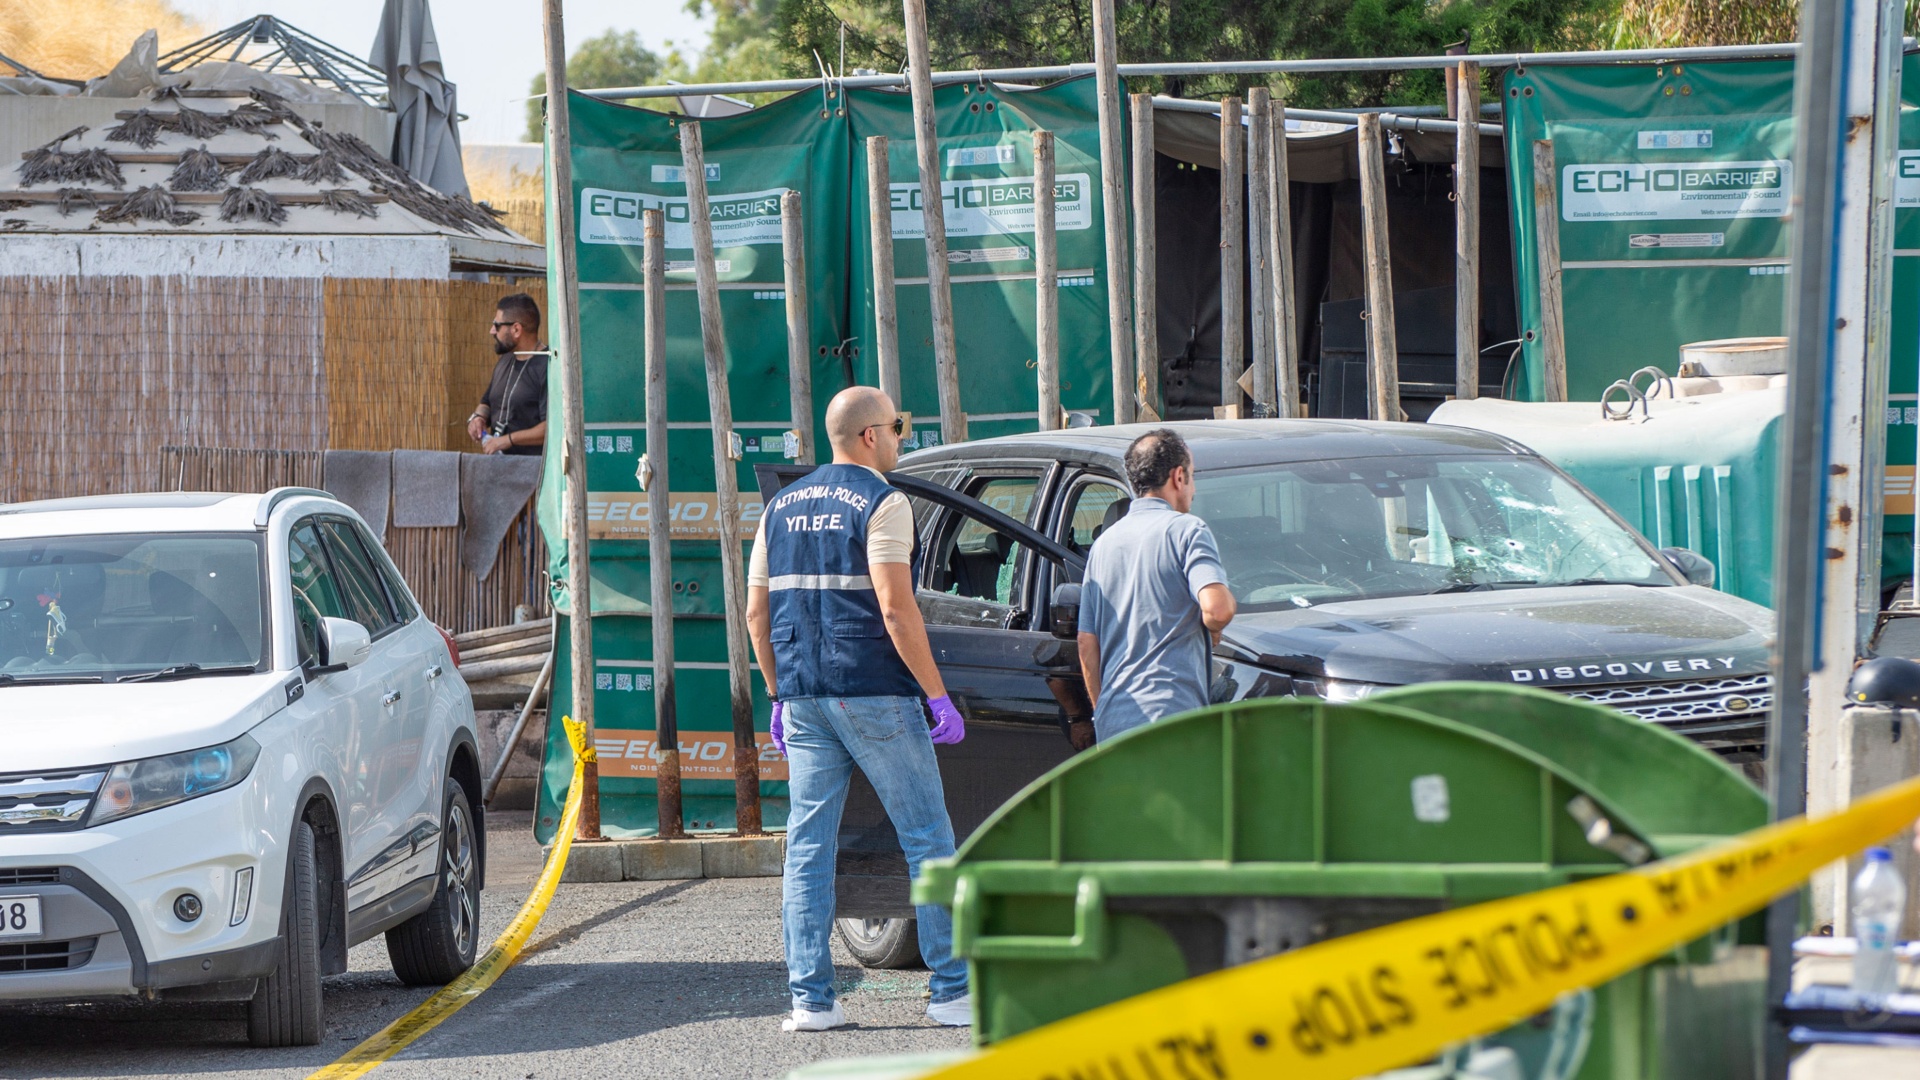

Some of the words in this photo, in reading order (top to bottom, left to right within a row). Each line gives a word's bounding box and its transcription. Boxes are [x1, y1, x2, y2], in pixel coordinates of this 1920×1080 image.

[1573, 169, 1679, 193] ECHO
[1685, 170, 1777, 186] BARRIER
[992, 184, 1076, 202] BARER
[1681, 192, 1751, 201] Environmentally
[1753, 190, 1781, 199] Sound
[710, 198, 778, 217] ARRIER
[1055, 203, 1081, 212] Sound
[712, 219, 756, 231] onmentally
[756, 217, 782, 226] Sound
[1510, 656, 1736, 682] DISCOVERY
[0, 902, 27, 930] 8
[1424, 897, 1605, 1009] POLICE
[1291, 966, 1416, 1057] STOP
